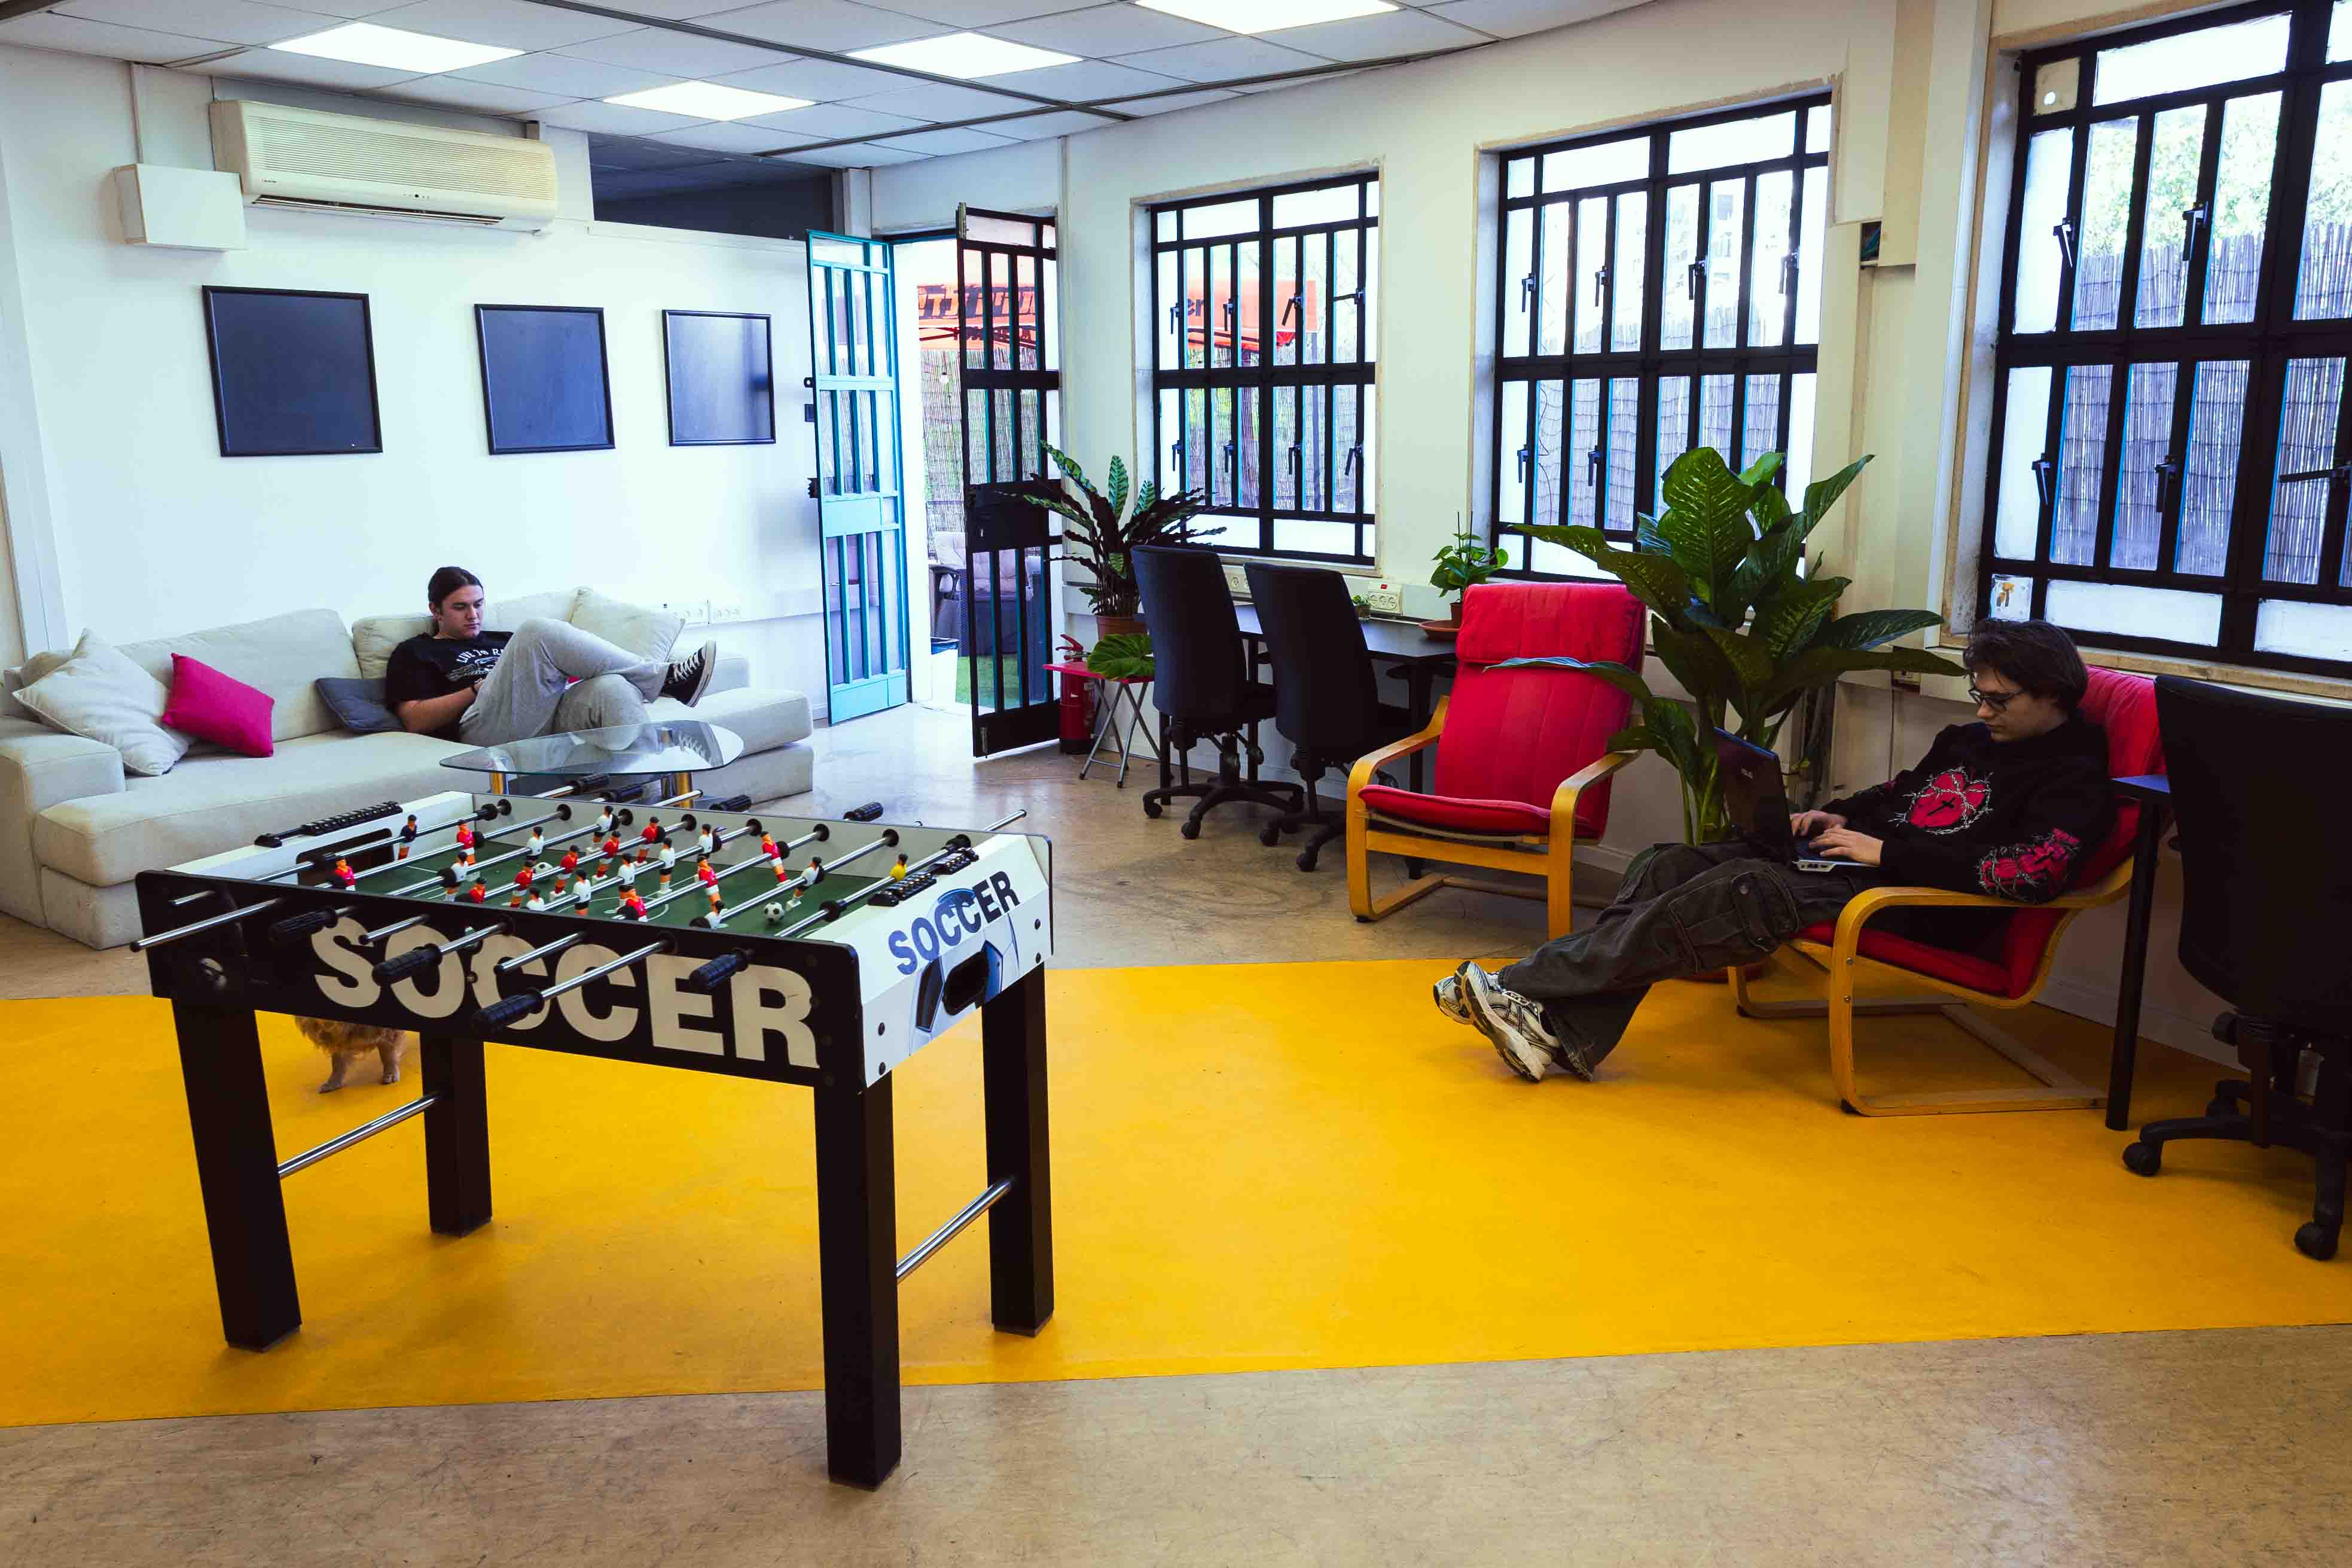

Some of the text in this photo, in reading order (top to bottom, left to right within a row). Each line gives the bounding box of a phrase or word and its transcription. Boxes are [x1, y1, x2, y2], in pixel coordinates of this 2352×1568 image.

[456, 651, 475, 663] LIVE
[888, 871, 1020, 975] SOCCER
[310, 917, 820, 1069] SOCCER
